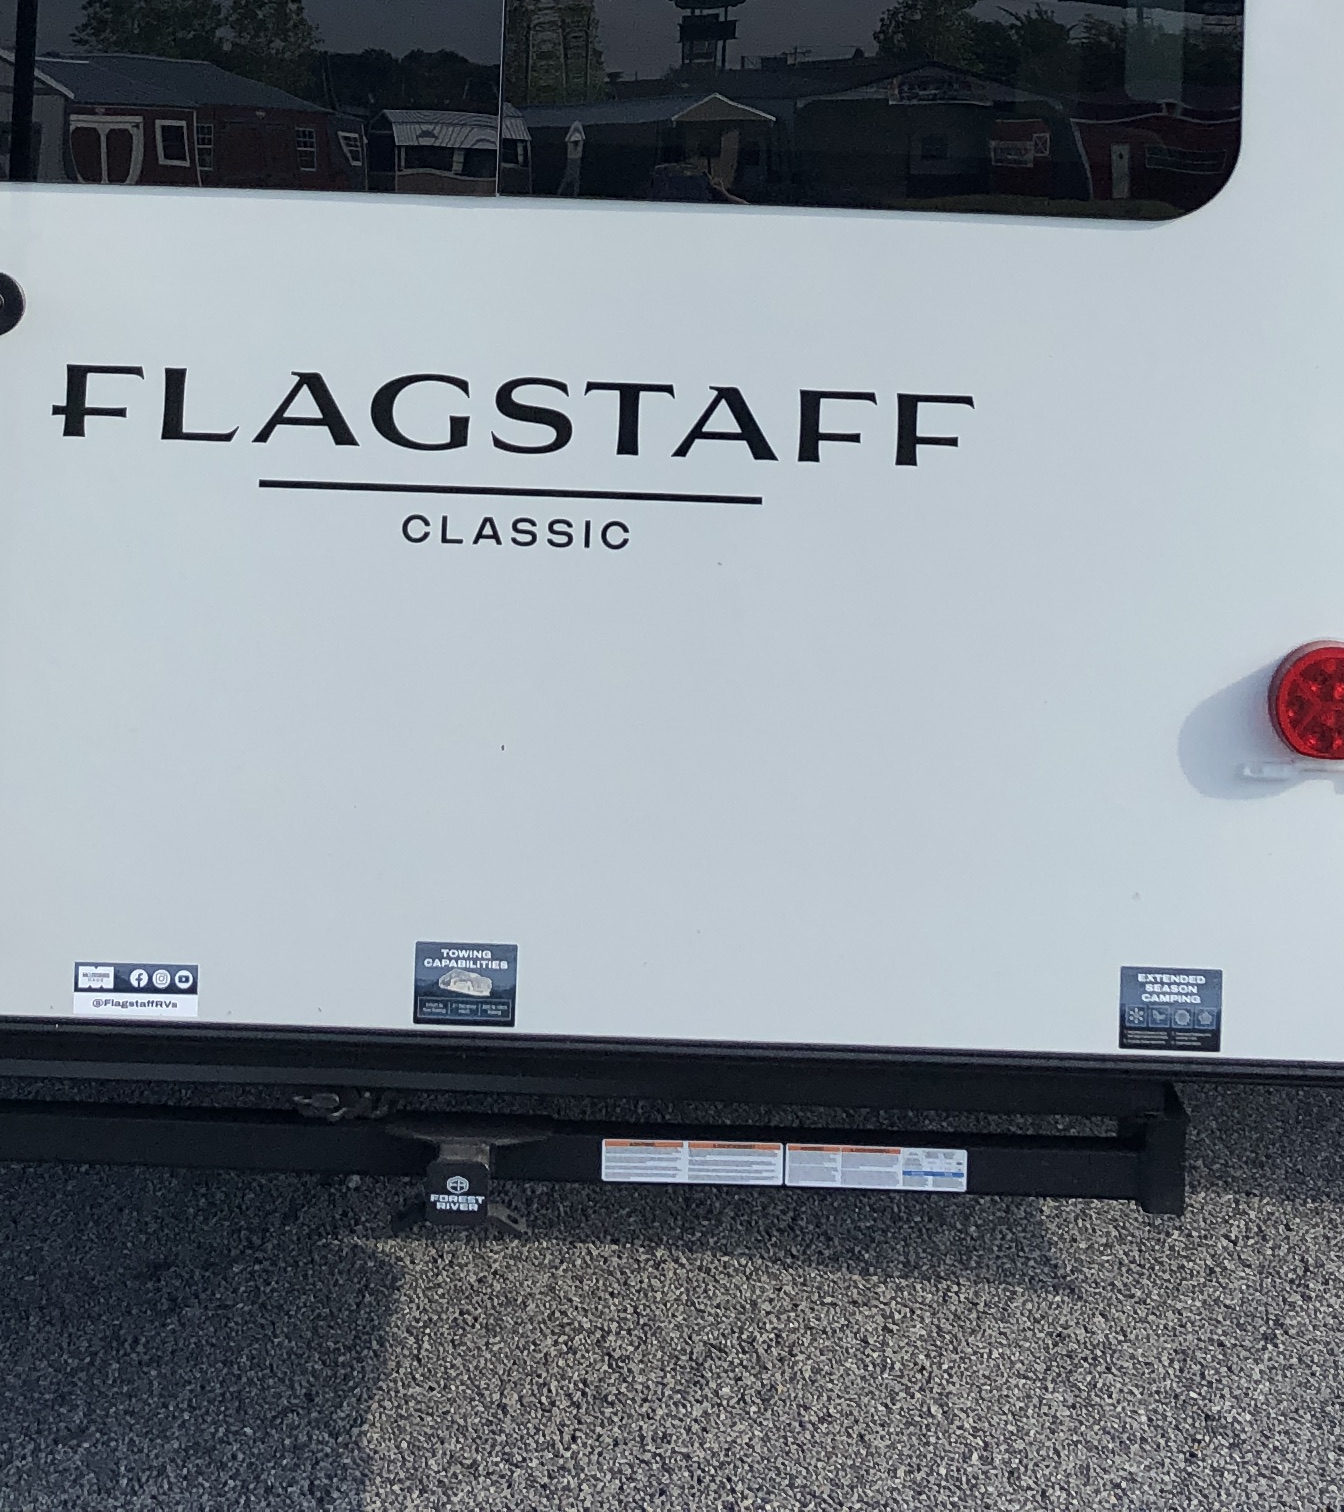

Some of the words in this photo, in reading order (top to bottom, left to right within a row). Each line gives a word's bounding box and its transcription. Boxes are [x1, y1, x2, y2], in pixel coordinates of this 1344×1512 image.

[51, 363, 975, 467] FLAGSTAFF
[401, 514, 631, 550] CLASSIC
[440, 948, 492, 959] TOWING
[423, 958, 509, 970] CAPABILITIES
[1137, 973, 1206, 984] EXTENDED
[1145, 983, 1198, 994] SEASON
[92, 998, 178, 1009] @FlagstaffRVs
[1141, 993, 1202, 1004] CAMPING
[430, 1193, 486, 1204] FOREST
[436, 1201, 479, 1212] RIVER
